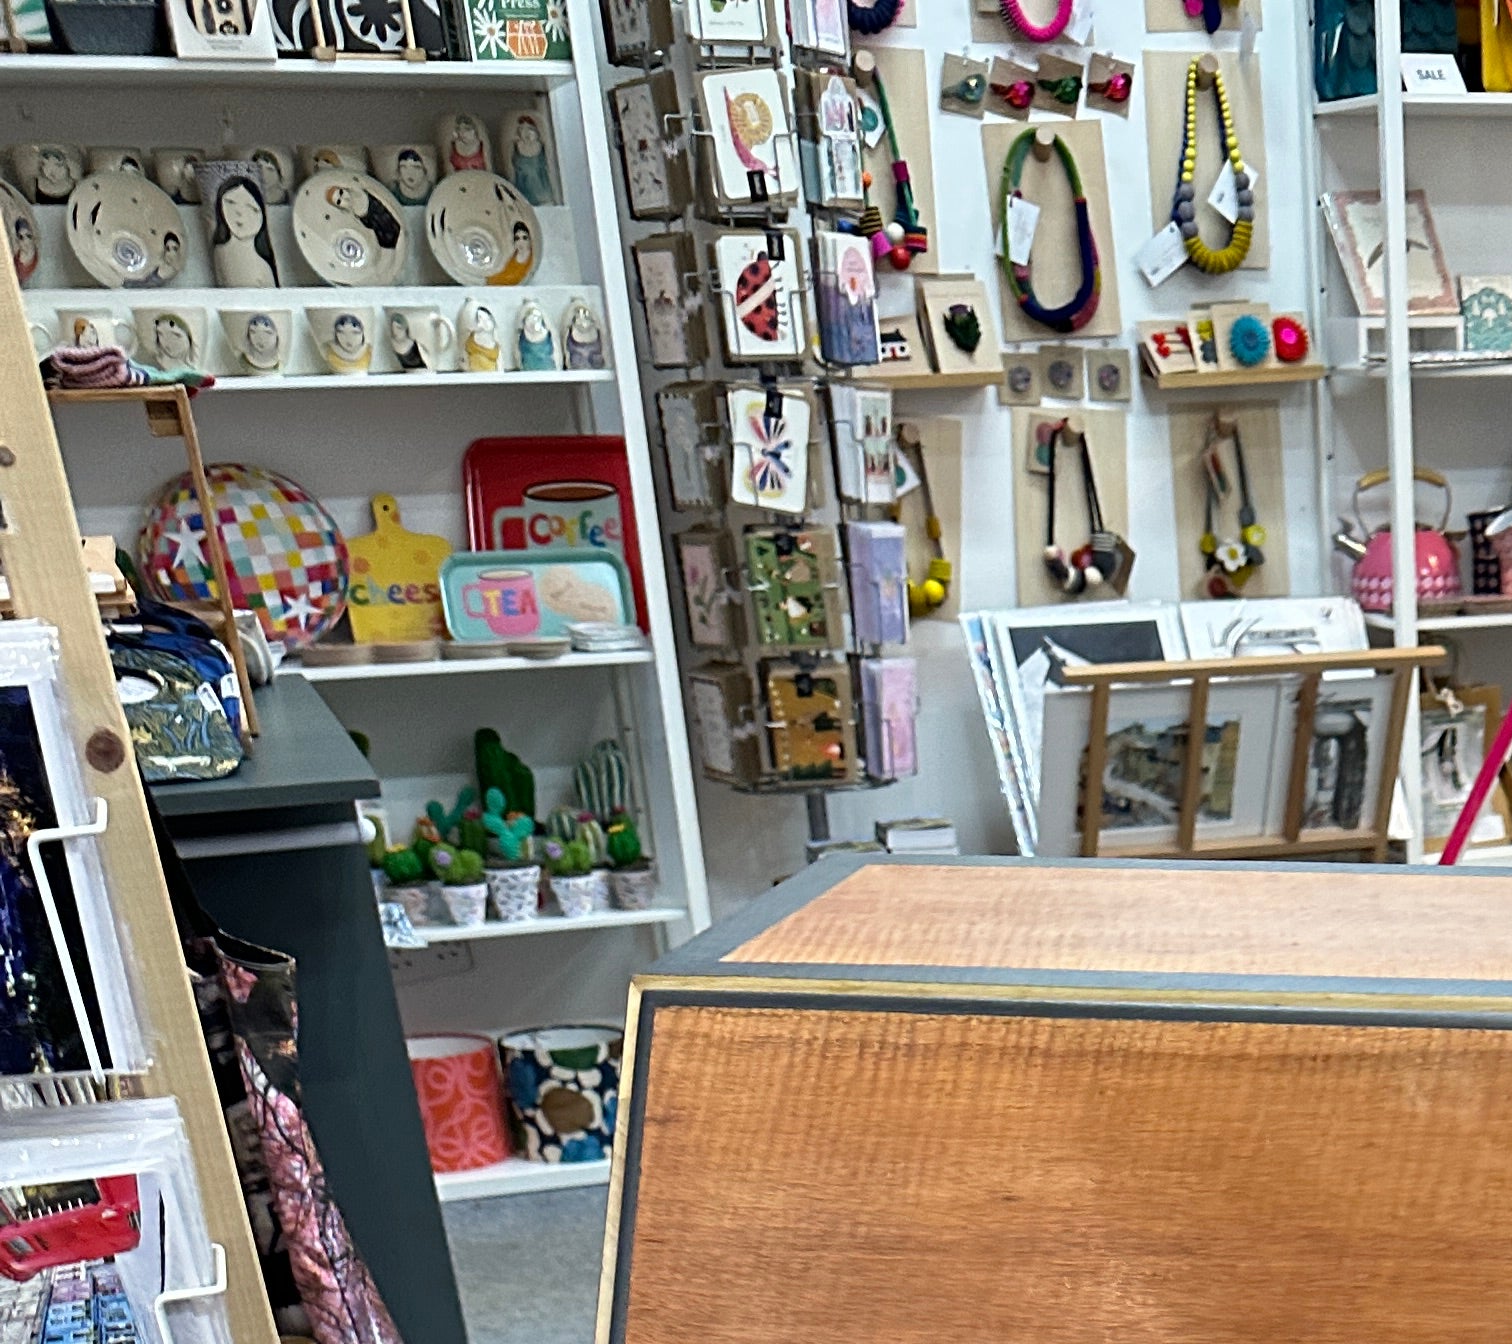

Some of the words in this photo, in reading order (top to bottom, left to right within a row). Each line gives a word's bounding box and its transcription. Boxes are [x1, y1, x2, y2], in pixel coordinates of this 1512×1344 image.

[1416, 69, 1446, 80] SALE
[349, 576, 441, 606] chees
[481, 588, 539, 617] TEA
